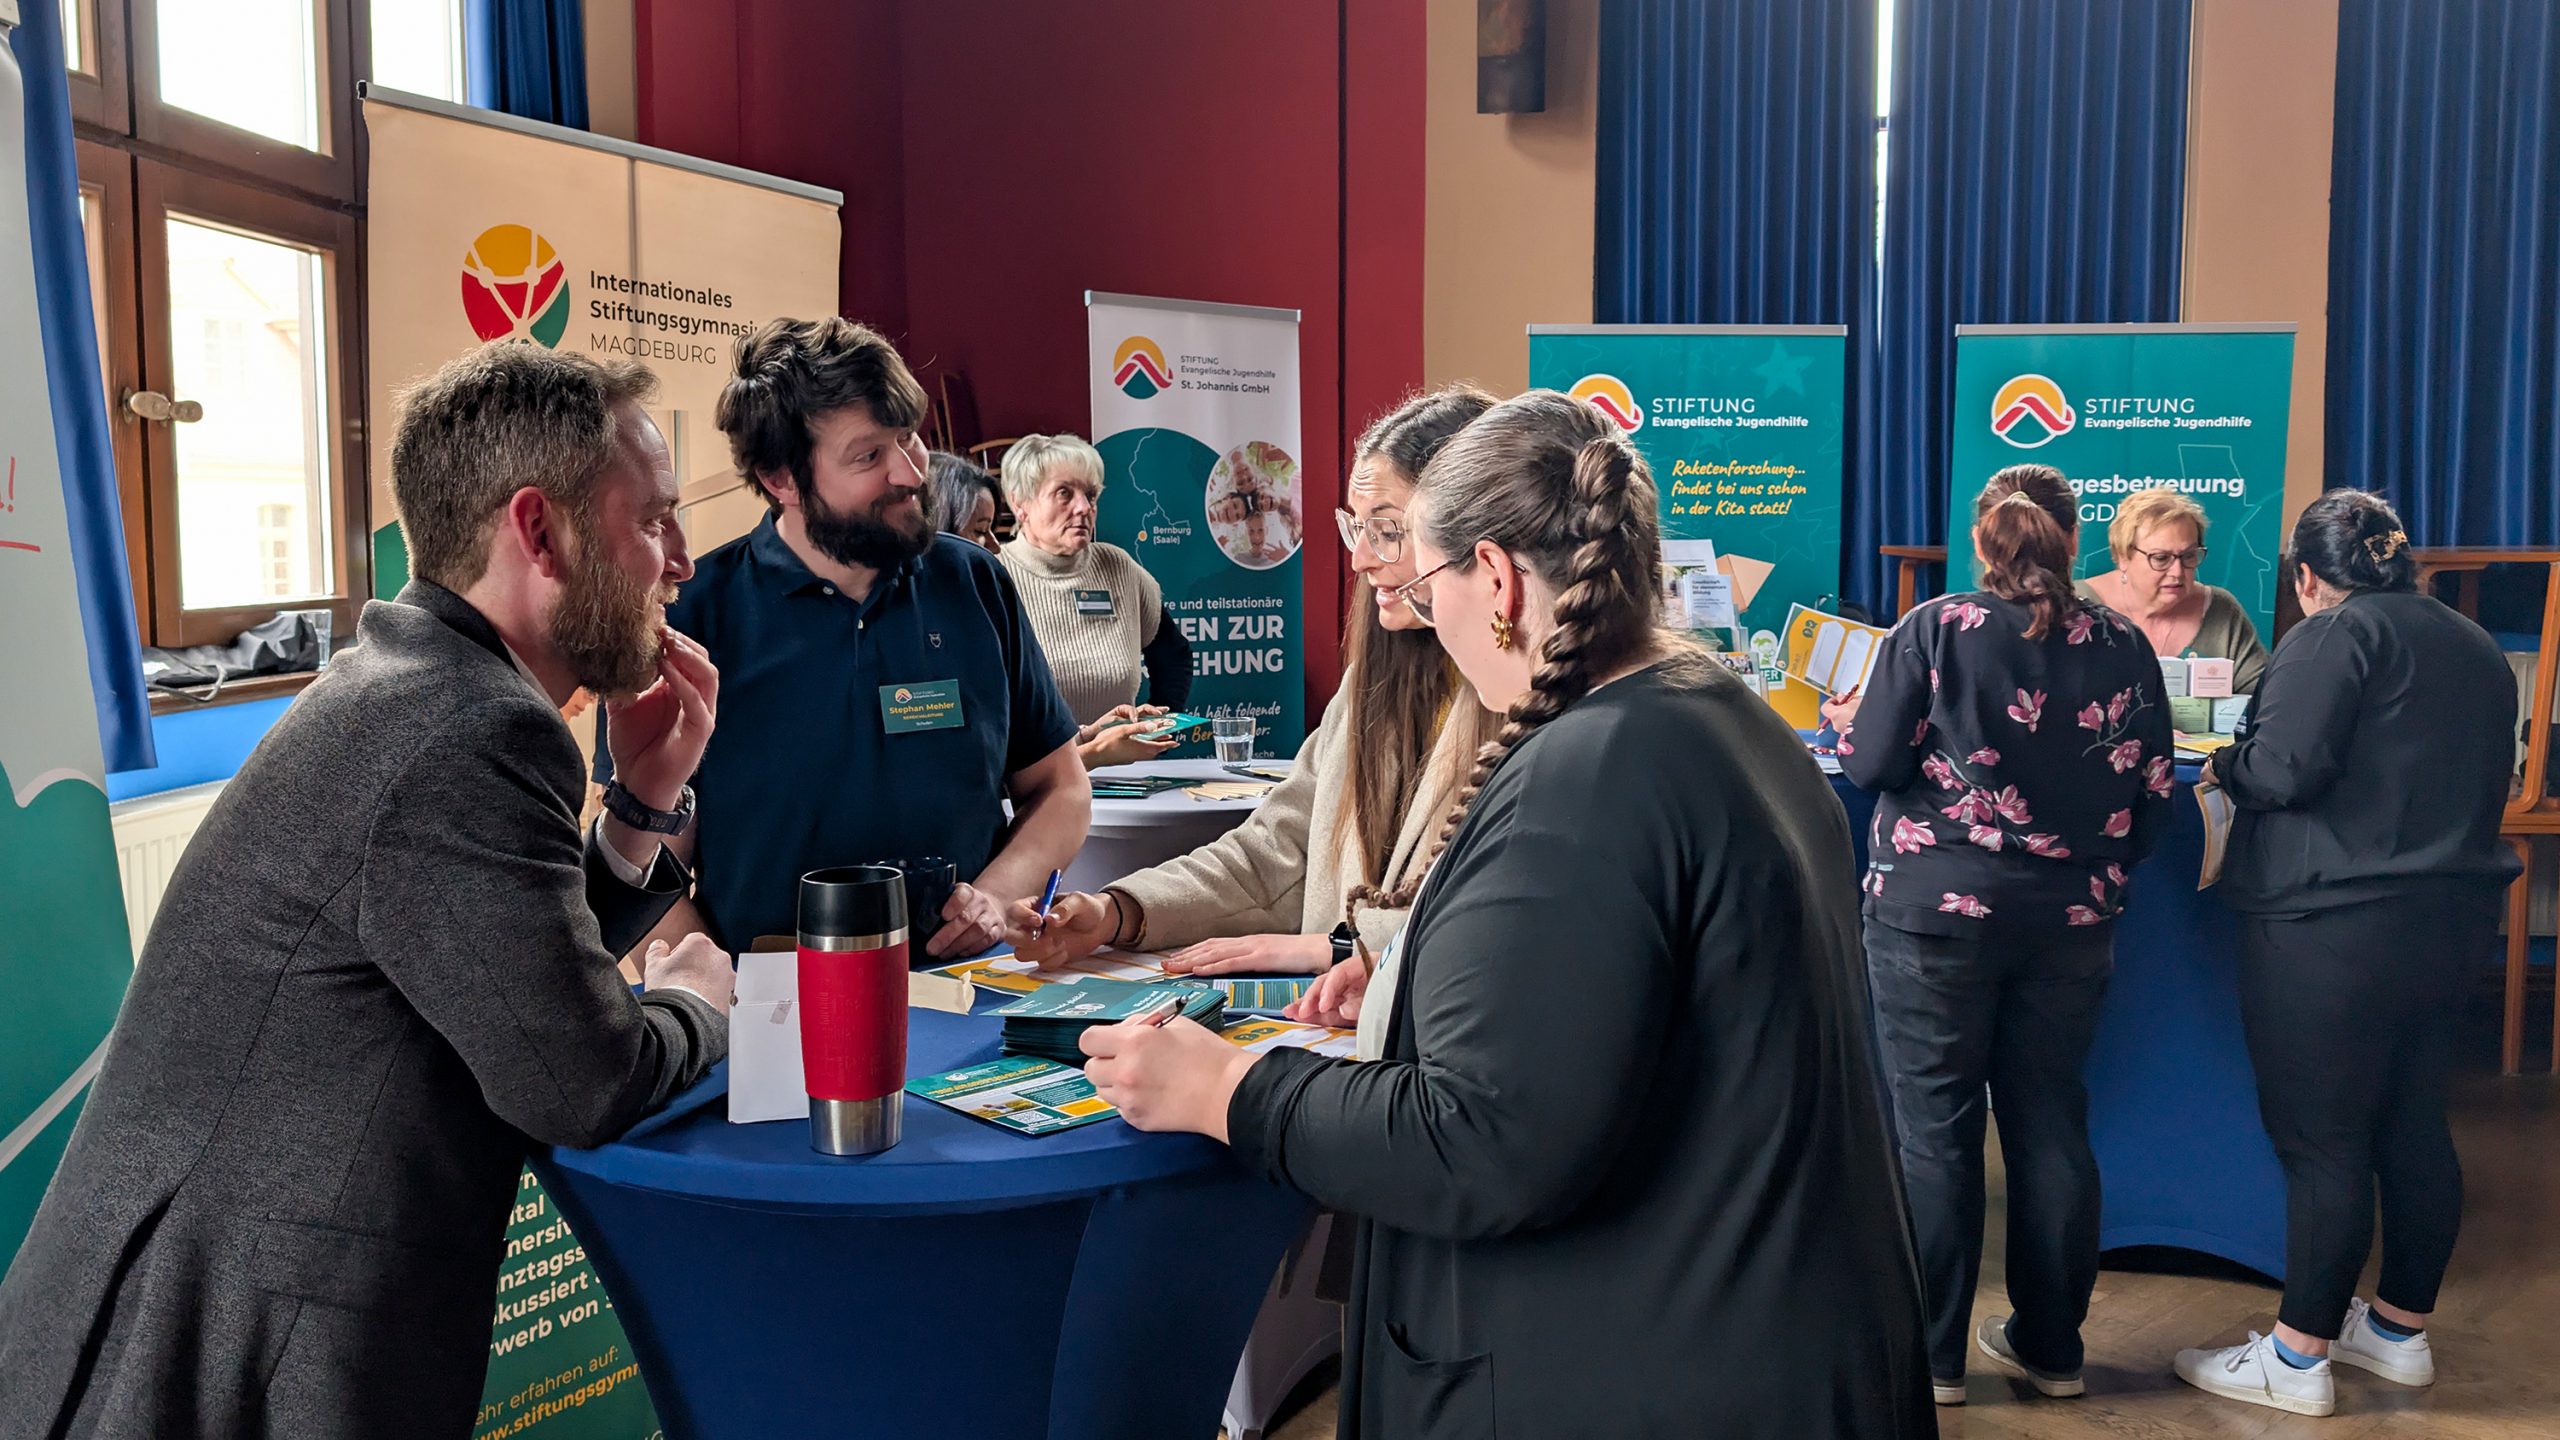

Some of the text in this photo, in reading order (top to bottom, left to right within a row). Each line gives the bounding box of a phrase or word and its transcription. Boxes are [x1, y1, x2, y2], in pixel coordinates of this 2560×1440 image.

[590, 270, 732, 308] Internationales
[590, 300, 757, 336] Stiftungsgymnasi
[591, 333, 716, 364] MAGDEBURG
[1180, 355, 1219, 365] STIFTUNG
[1181, 365, 1276, 378] Evangelische Jugendhilfe
[1181, 380, 1270, 394] St. Johannis GmbH
[1652, 397, 1755, 413] STIFTUNG
[2085, 398, 2195, 414] STIFTUNG
[1652, 416, 1808, 428] Evangelische Jugendhilfe
[2085, 416, 2252, 429] Evangelische Jugendhilfe
[1672, 460, 1806, 477] Raketenforschung...
[1671, 480, 1807, 496] findet bei uns schon
[2069, 474, 2244, 497] gesbetreuung
[1671, 499, 1792, 515] in der Kita statt!
[1153, 526, 1191, 536] Bernburg
[1153, 535, 1180, 544] (Saale)
[1180, 599, 1203, 610] und
[1207, 597, 1283, 610] teilstationäre
[1228, 615, 1284, 640] ZUR
[1192, 648, 1284, 677] EHUNG
[889, 705, 924, 714] Stephan
[497, 1246, 586, 1292] nztagss
[494, 1271, 588, 1325] kussiert
[490, 1300, 598, 1356] werb von
[476, 1345, 619, 1426] ehr erfahren auf:
